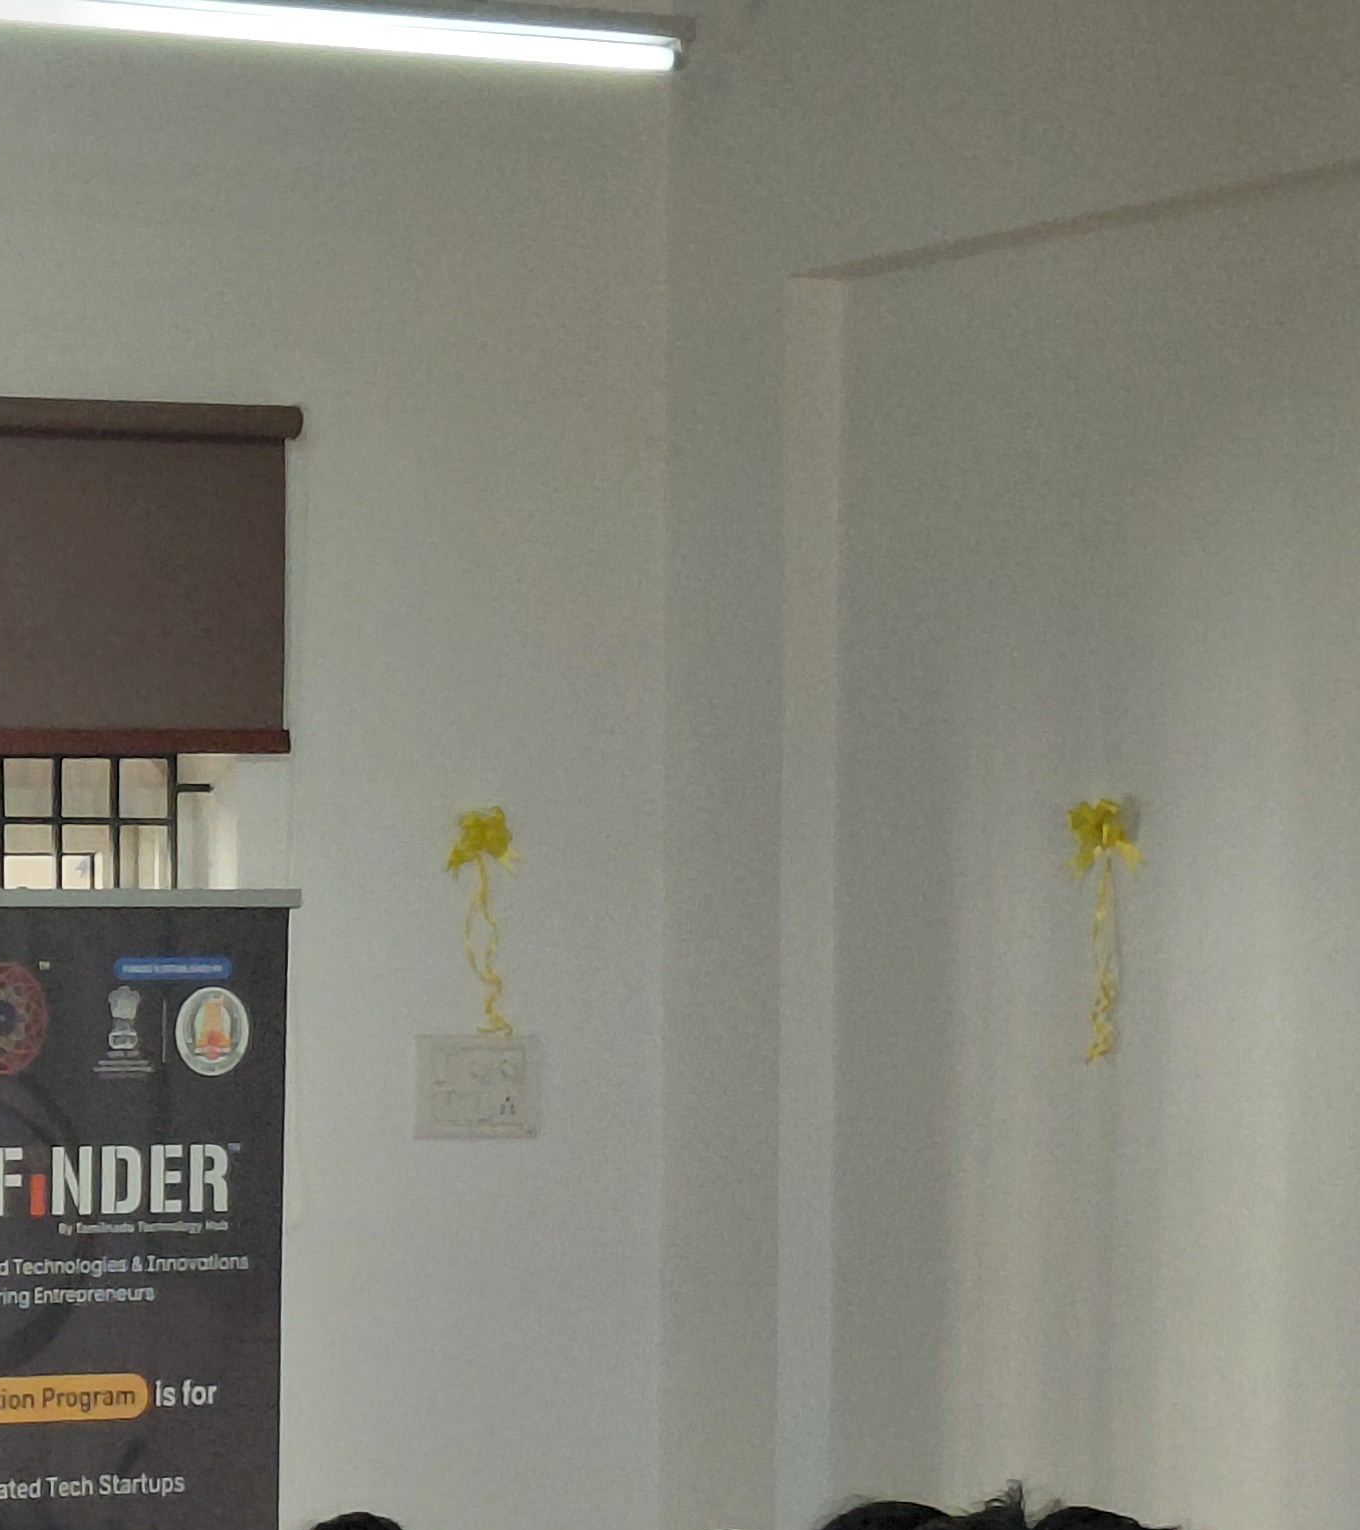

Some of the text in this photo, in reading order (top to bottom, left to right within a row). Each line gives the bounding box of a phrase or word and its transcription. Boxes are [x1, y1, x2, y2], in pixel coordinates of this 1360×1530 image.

[12, 1255, 129, 1278] Technologies
[131, 1254, 143, 1272] &
[144, 1253, 249, 1272] Innovations
[34, 1285, 156, 1307] Entrepreneurs
[41, 1387, 136, 1413] Program
[153, 1379, 177, 1407] is
[182, 1378, 218, 1406] for
[45, 1475, 94, 1498] Tech
[98, 1472, 185, 1498] Startups
